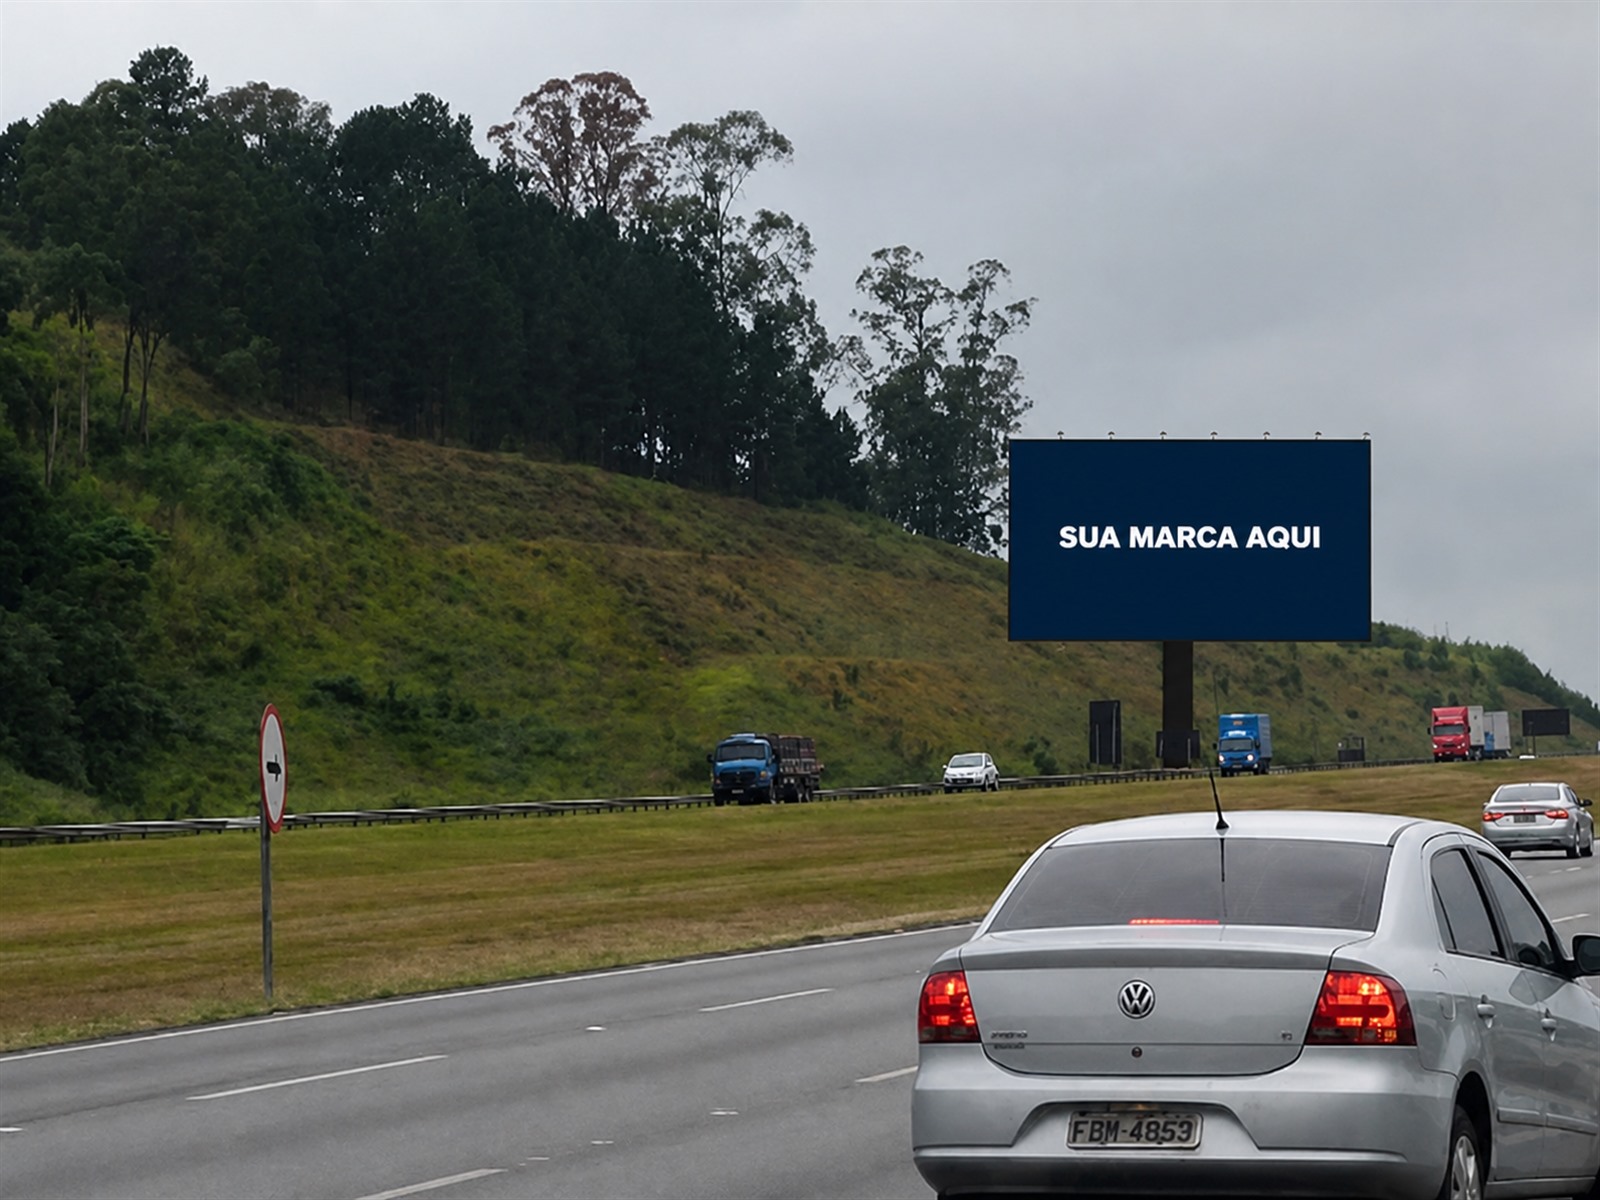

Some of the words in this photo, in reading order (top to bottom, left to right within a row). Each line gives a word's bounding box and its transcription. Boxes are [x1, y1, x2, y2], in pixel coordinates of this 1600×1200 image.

[1058, 525, 1121, 549] SUA
[1129, 525, 1239, 549] MARCA
[1245, 525, 1321, 550] AQUI
[1119, 981, 1154, 1018] VW
[1072, 1119, 1194, 1143] FBM-4853
